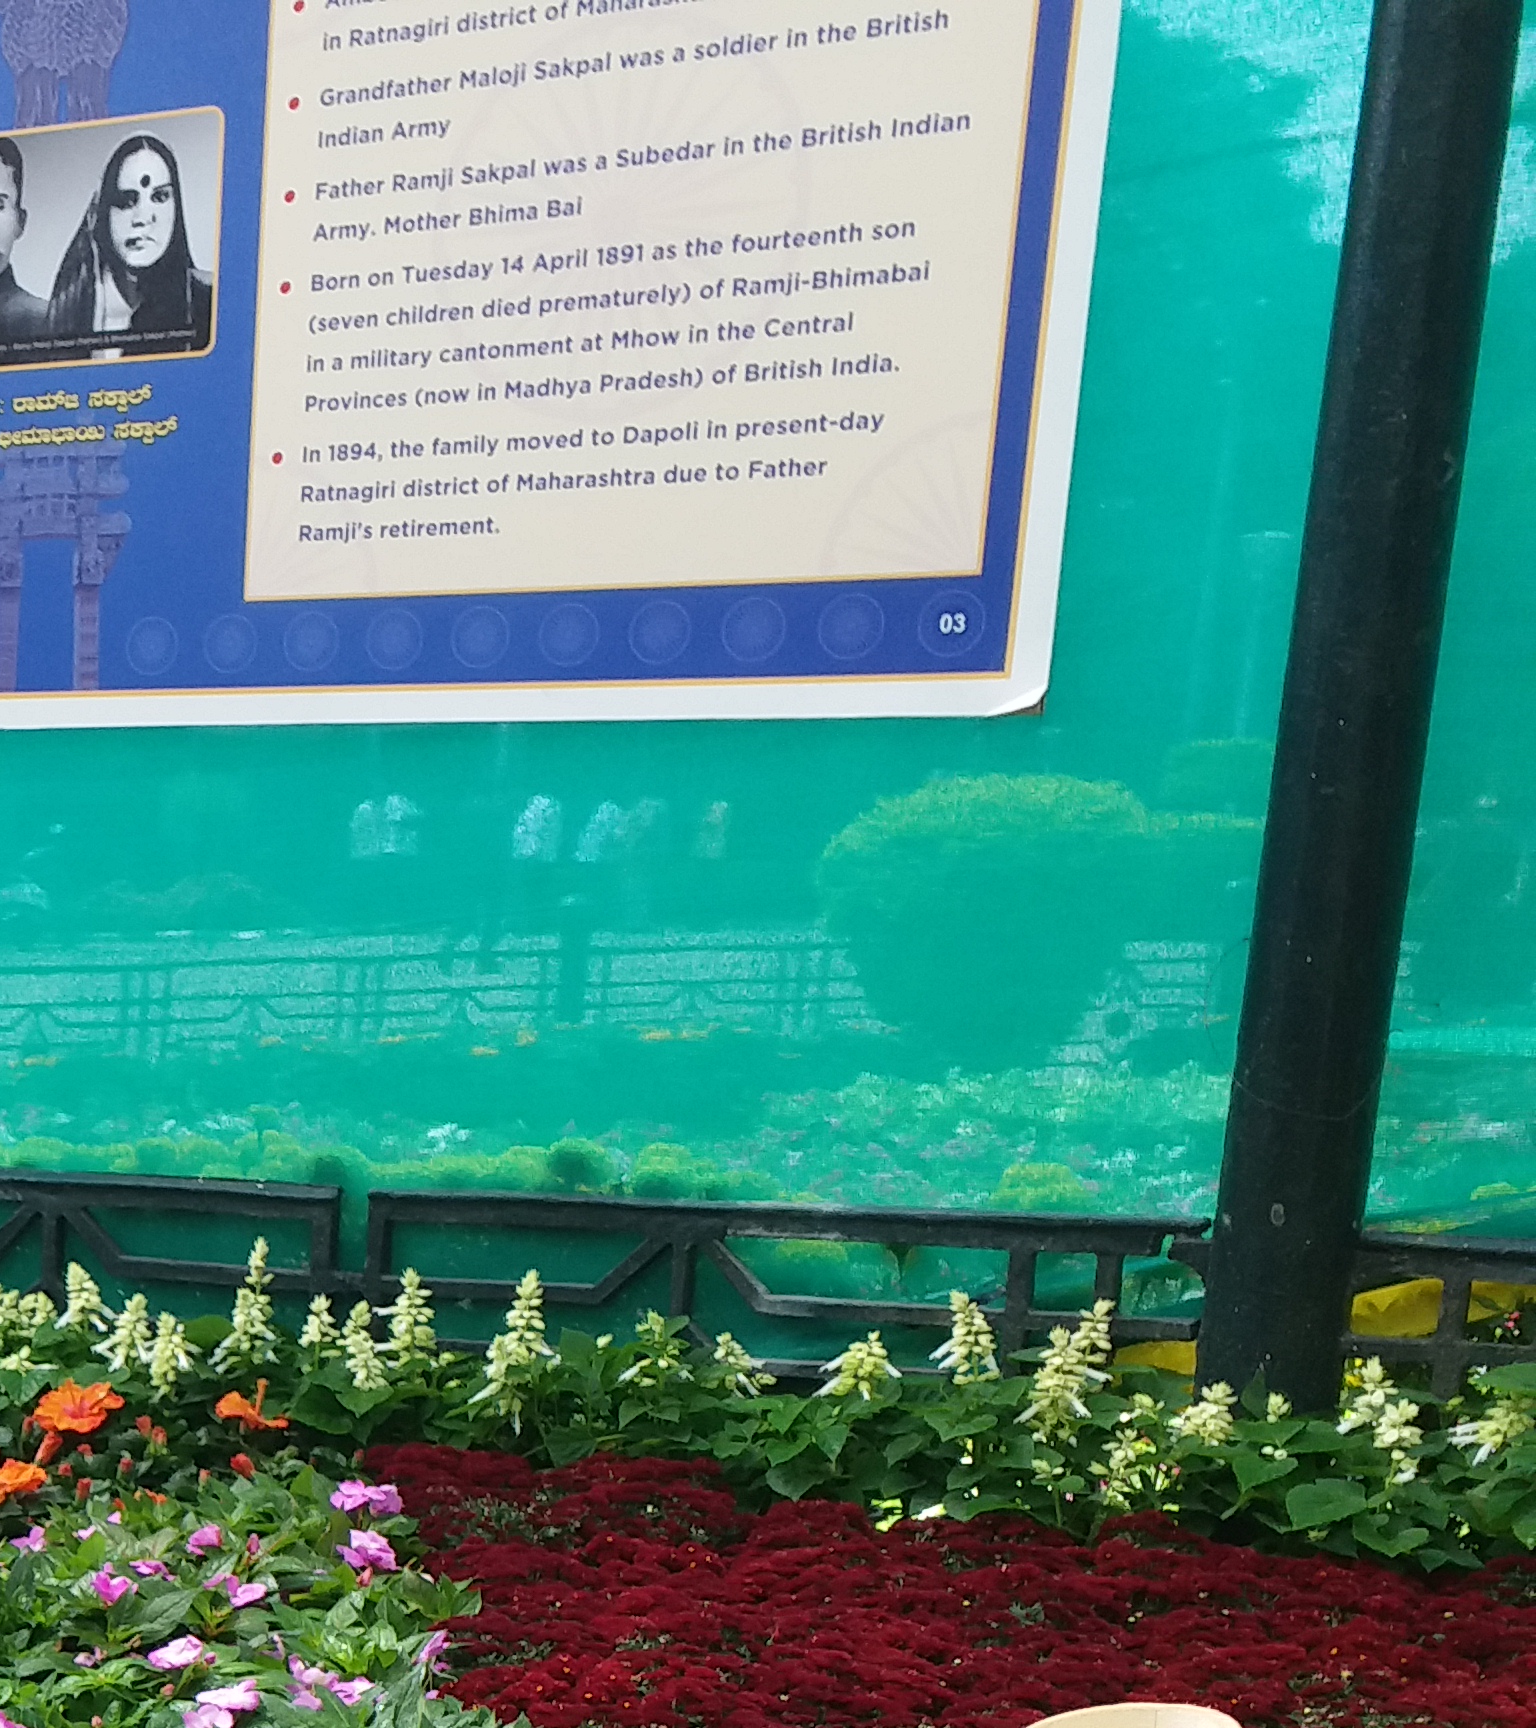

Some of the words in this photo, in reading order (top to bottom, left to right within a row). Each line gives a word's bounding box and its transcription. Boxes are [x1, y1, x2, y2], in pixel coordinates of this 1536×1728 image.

[322, 31, 342, 52] in
[349, 15, 450, 48] Ratnagiri
[456, 4, 538, 33] district
[544, 0, 569, 21] of
[319, 76, 453, 107] Grandfather
[459, 61, 527, 90] Maloji
[533, 51, 612, 81] Sakpal
[619, 49, 665, 69] was
[671, 46, 686, 63] a
[693, 32, 779, 61] soldier
[786, 27, 808, 49] in
[816, 23, 857, 45] the
[865, 8, 949, 39] British
[315, 177, 386, 201] Father
[392, 166, 454, 193] Ramji
[460, 158, 536, 185] Sakpal
[543, 156, 588, 177] was
[594, 154, 608, 171] a
[615, 140, 716, 168] Subedar
[723, 136, 744, 157] in
[752, 131, 793, 154] the
[801, 119, 882, 149] British
[891, 112, 971, 139] Indian
[317, 125, 384, 149] Indian
[391, 119, 451, 141] Army
[312, 222, 377, 243] Army.
[383, 211, 462, 235] Mother
[468, 203, 539, 227] Bhima
[546, 195, 583, 219] Bai
[310, 273, 361, 293] Born
[367, 271, 394, 287] on
[401, 259, 494, 285] Tuesday
[500, 254, 525, 275] 14
[532, 247, 589, 275] April
[596, 243, 644, 267] 1891
[651, 244, 678, 261] as
[684, 236, 724, 259] the
[731, 222, 863, 254] fourteenth
[871, 221, 916, 241] son
[308, 313, 379, 335] (seven
[385, 303, 474, 327] children
[481, 295, 532, 319] died
[538, 282, 691, 318] prematurely)
[699, 277, 726, 300] of
[731, 259, 931, 297] Ramji-Bhimabai
[306, 354, 325, 373] in
[331, 356, 343, 371] a
[350, 348, 433, 370] military
[439, 335, 574, 364] cantonment
[580, 332, 604, 353] at
[610, 328, 681, 351] Mhow
[688, 323, 709, 344] in
[717, 320, 756, 342] the
[764, 311, 854, 338] Central
[304, 390, 408, 413] Provinces
[414, 387, 470, 408] (now
[477, 382, 497, 402] in
[503, 377, 592, 400] Madhya
[599, 367, 704, 393] Pradesh)
[711, 363, 738, 385] of
[744, 357, 823, 383] British
[831, 352, 900, 377] India.
[302, 445, 321, 464] In
[328, 441, 383, 463] 1894,
[390, 439, 425, 459] the
[431, 434, 500, 457] family
[506, 428, 584, 452] moved
[591, 428, 615, 447] to
[622, 420, 699, 447] Dapoli
[706, 419, 728, 440] in
[735, 410, 885, 442] present-day
[300, 479, 396, 504] Ratnagiri
[402, 476, 480, 498] district
[486, 473, 510, 494] of
[516, 467, 656, 493] Maharashtra
[663, 463, 707, 484] due
[714, 462, 740, 482] to
[748, 457, 829, 480] Father
[298, 521, 373, 544] Ramji's
[379, 516, 500, 539] retirement.
[938, 612, 968, 636] 03
